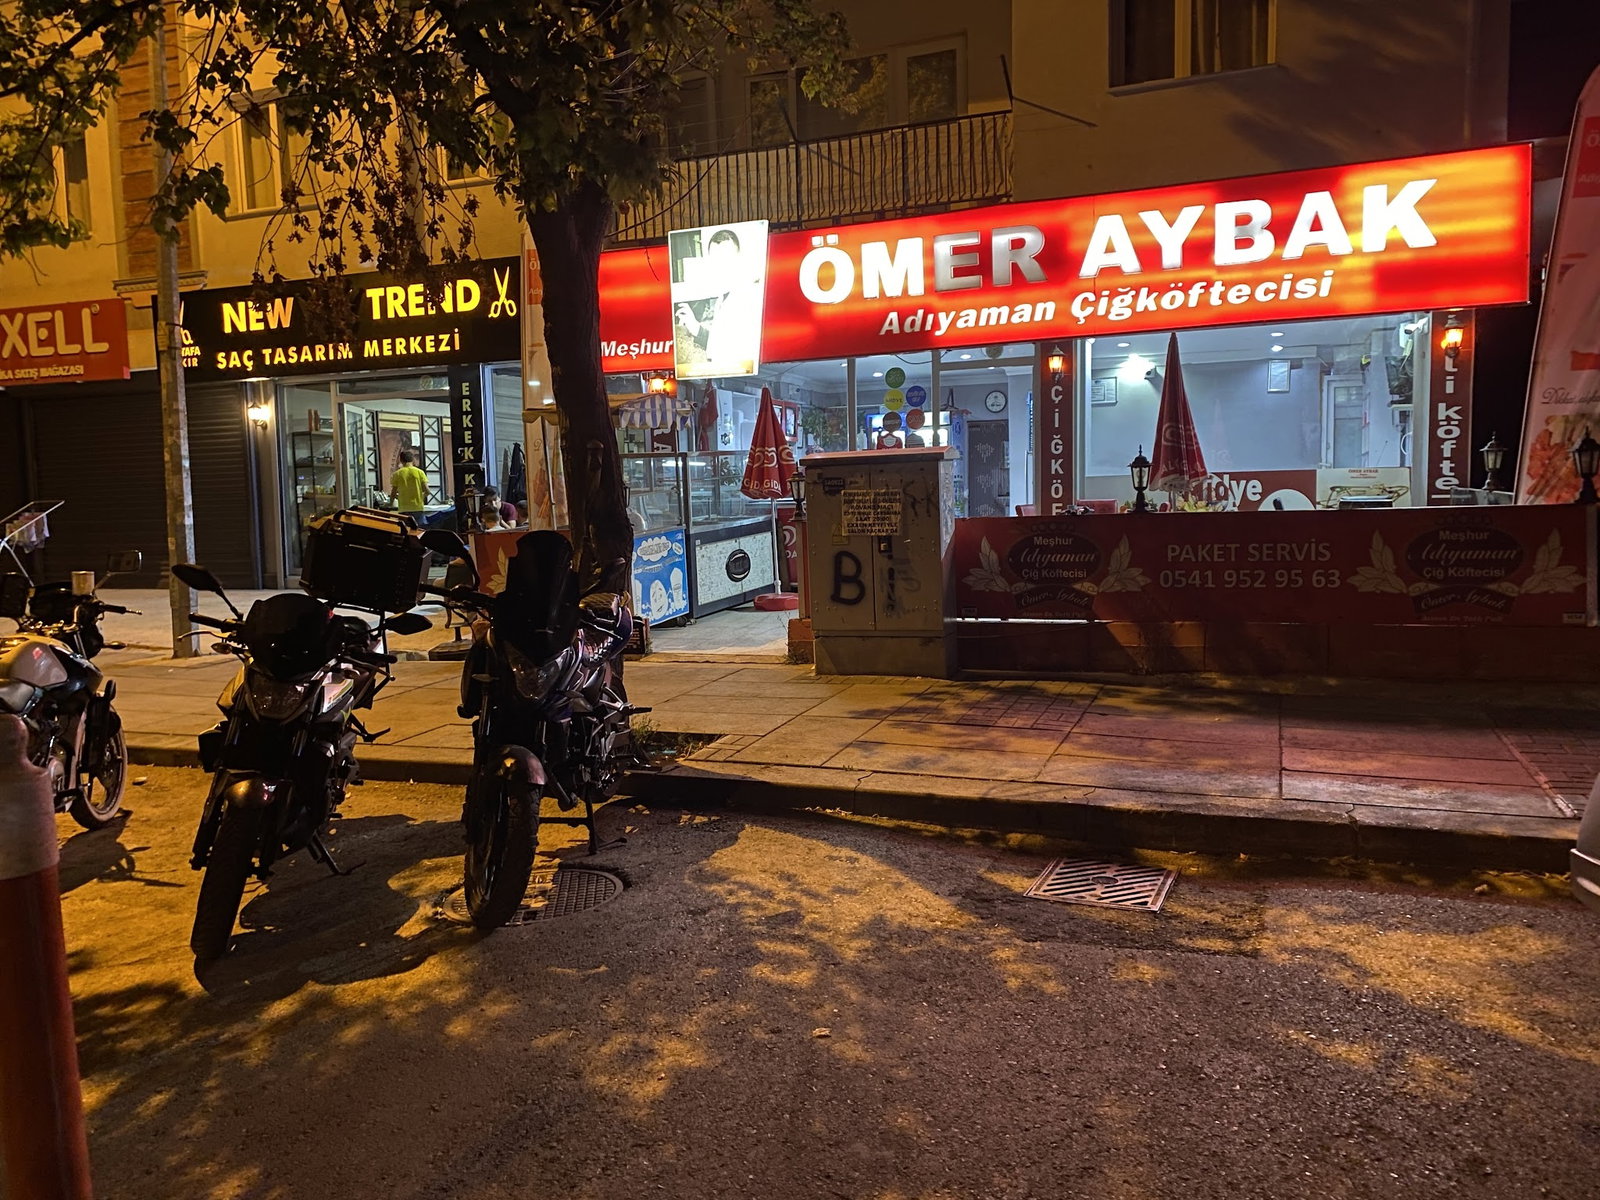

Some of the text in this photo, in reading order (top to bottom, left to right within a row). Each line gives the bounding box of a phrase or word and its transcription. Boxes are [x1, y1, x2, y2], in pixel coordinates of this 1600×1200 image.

[799, 178, 1438, 304] ÖMER AYBAK
[222, 279, 481, 334] NEW TREND
[600, 270, 1334, 358] Meşhur Adıyaman Çiğköftecisi
[217, 328, 460, 371] SAÇ TASARIM MERKEZİ
[461, 382, 475, 462] ERKEK
[1034, 537, 1073, 547] Meşhur
[1439, 530, 1490, 541] Meşhur
[1167, 538, 1332, 562] PAKET SERVİS
[1042, 568, 1087, 579] Köftecisi
[1159, 569, 1341, 588] 0541 952 95 63
[1448, 566, 1505, 577] Köftecisi
